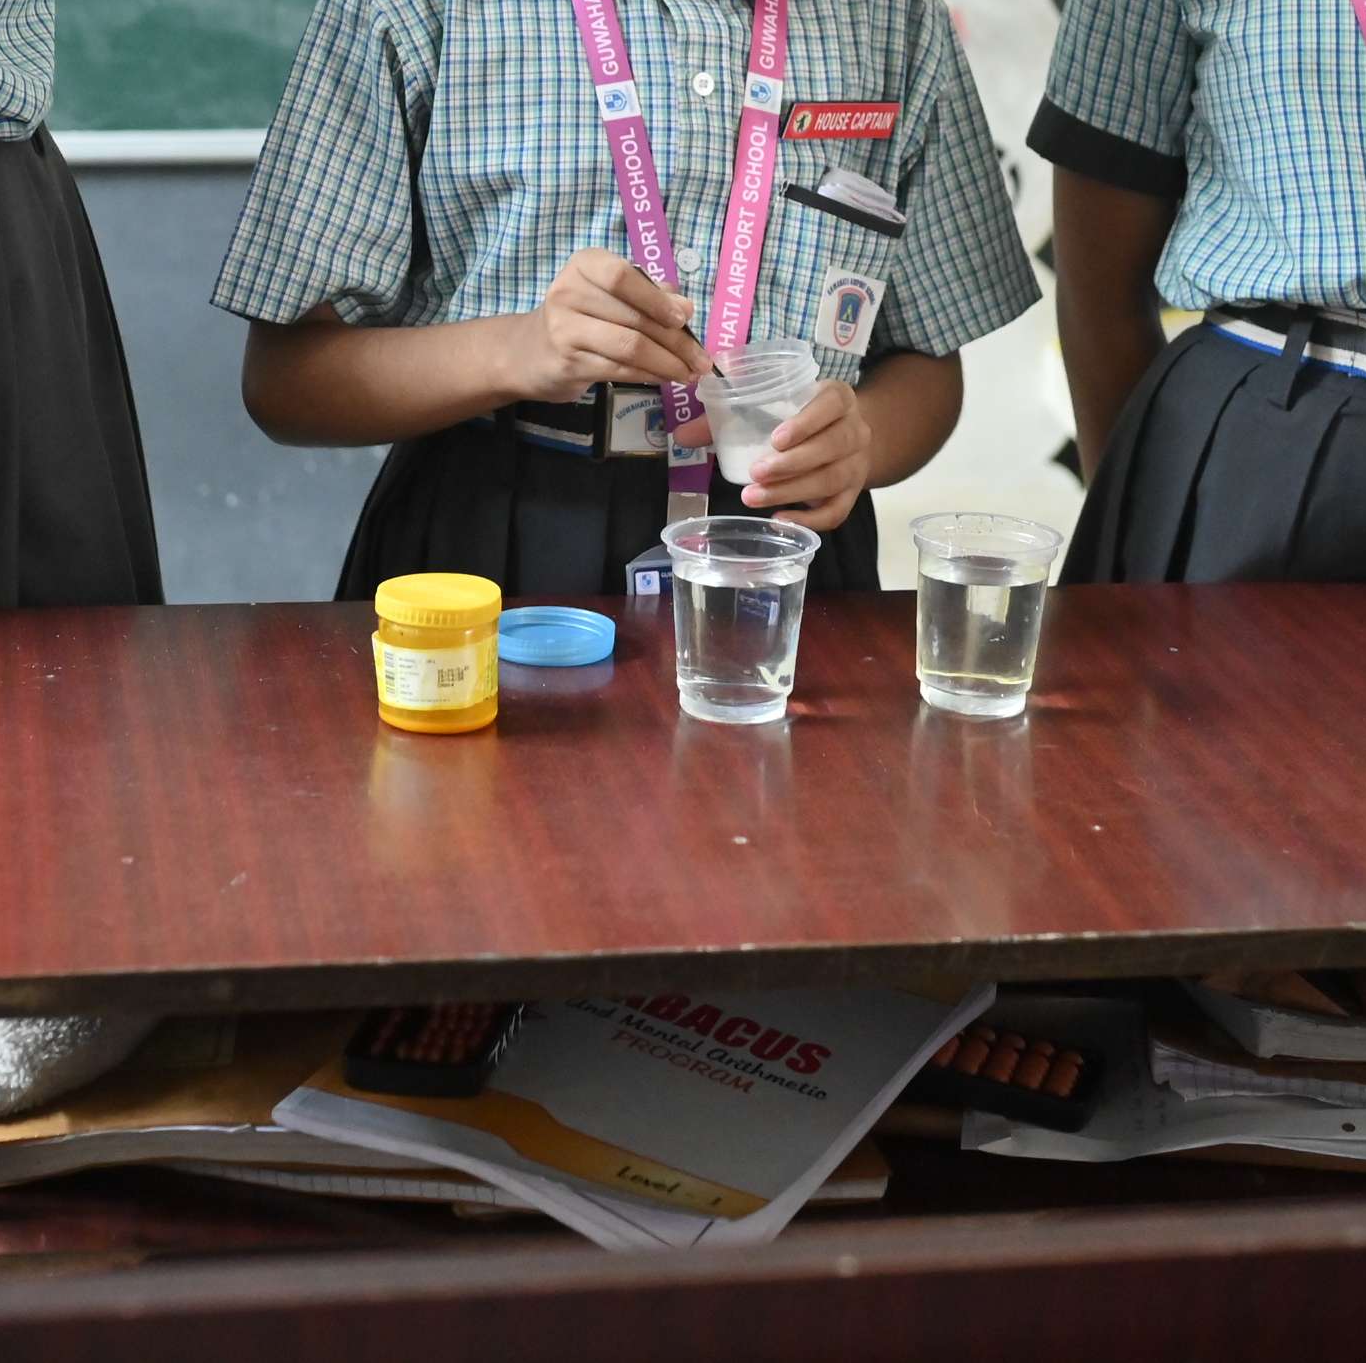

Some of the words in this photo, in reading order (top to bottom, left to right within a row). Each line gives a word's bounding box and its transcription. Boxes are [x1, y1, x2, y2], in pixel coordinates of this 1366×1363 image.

[813, 111, 851, 131] HOUSE
[849, 111, 895, 131] CAPTAIN
[619, 126, 652, 214] SCHOOL
[726, 206, 756, 298] AIRPORT
[742, 121, 769, 203] SCHOOL
[608, 1028, 756, 1095] PROGRAM
[621, 1012, 706, 1056] Mental
[614, 1163, 682, 1197] Level
